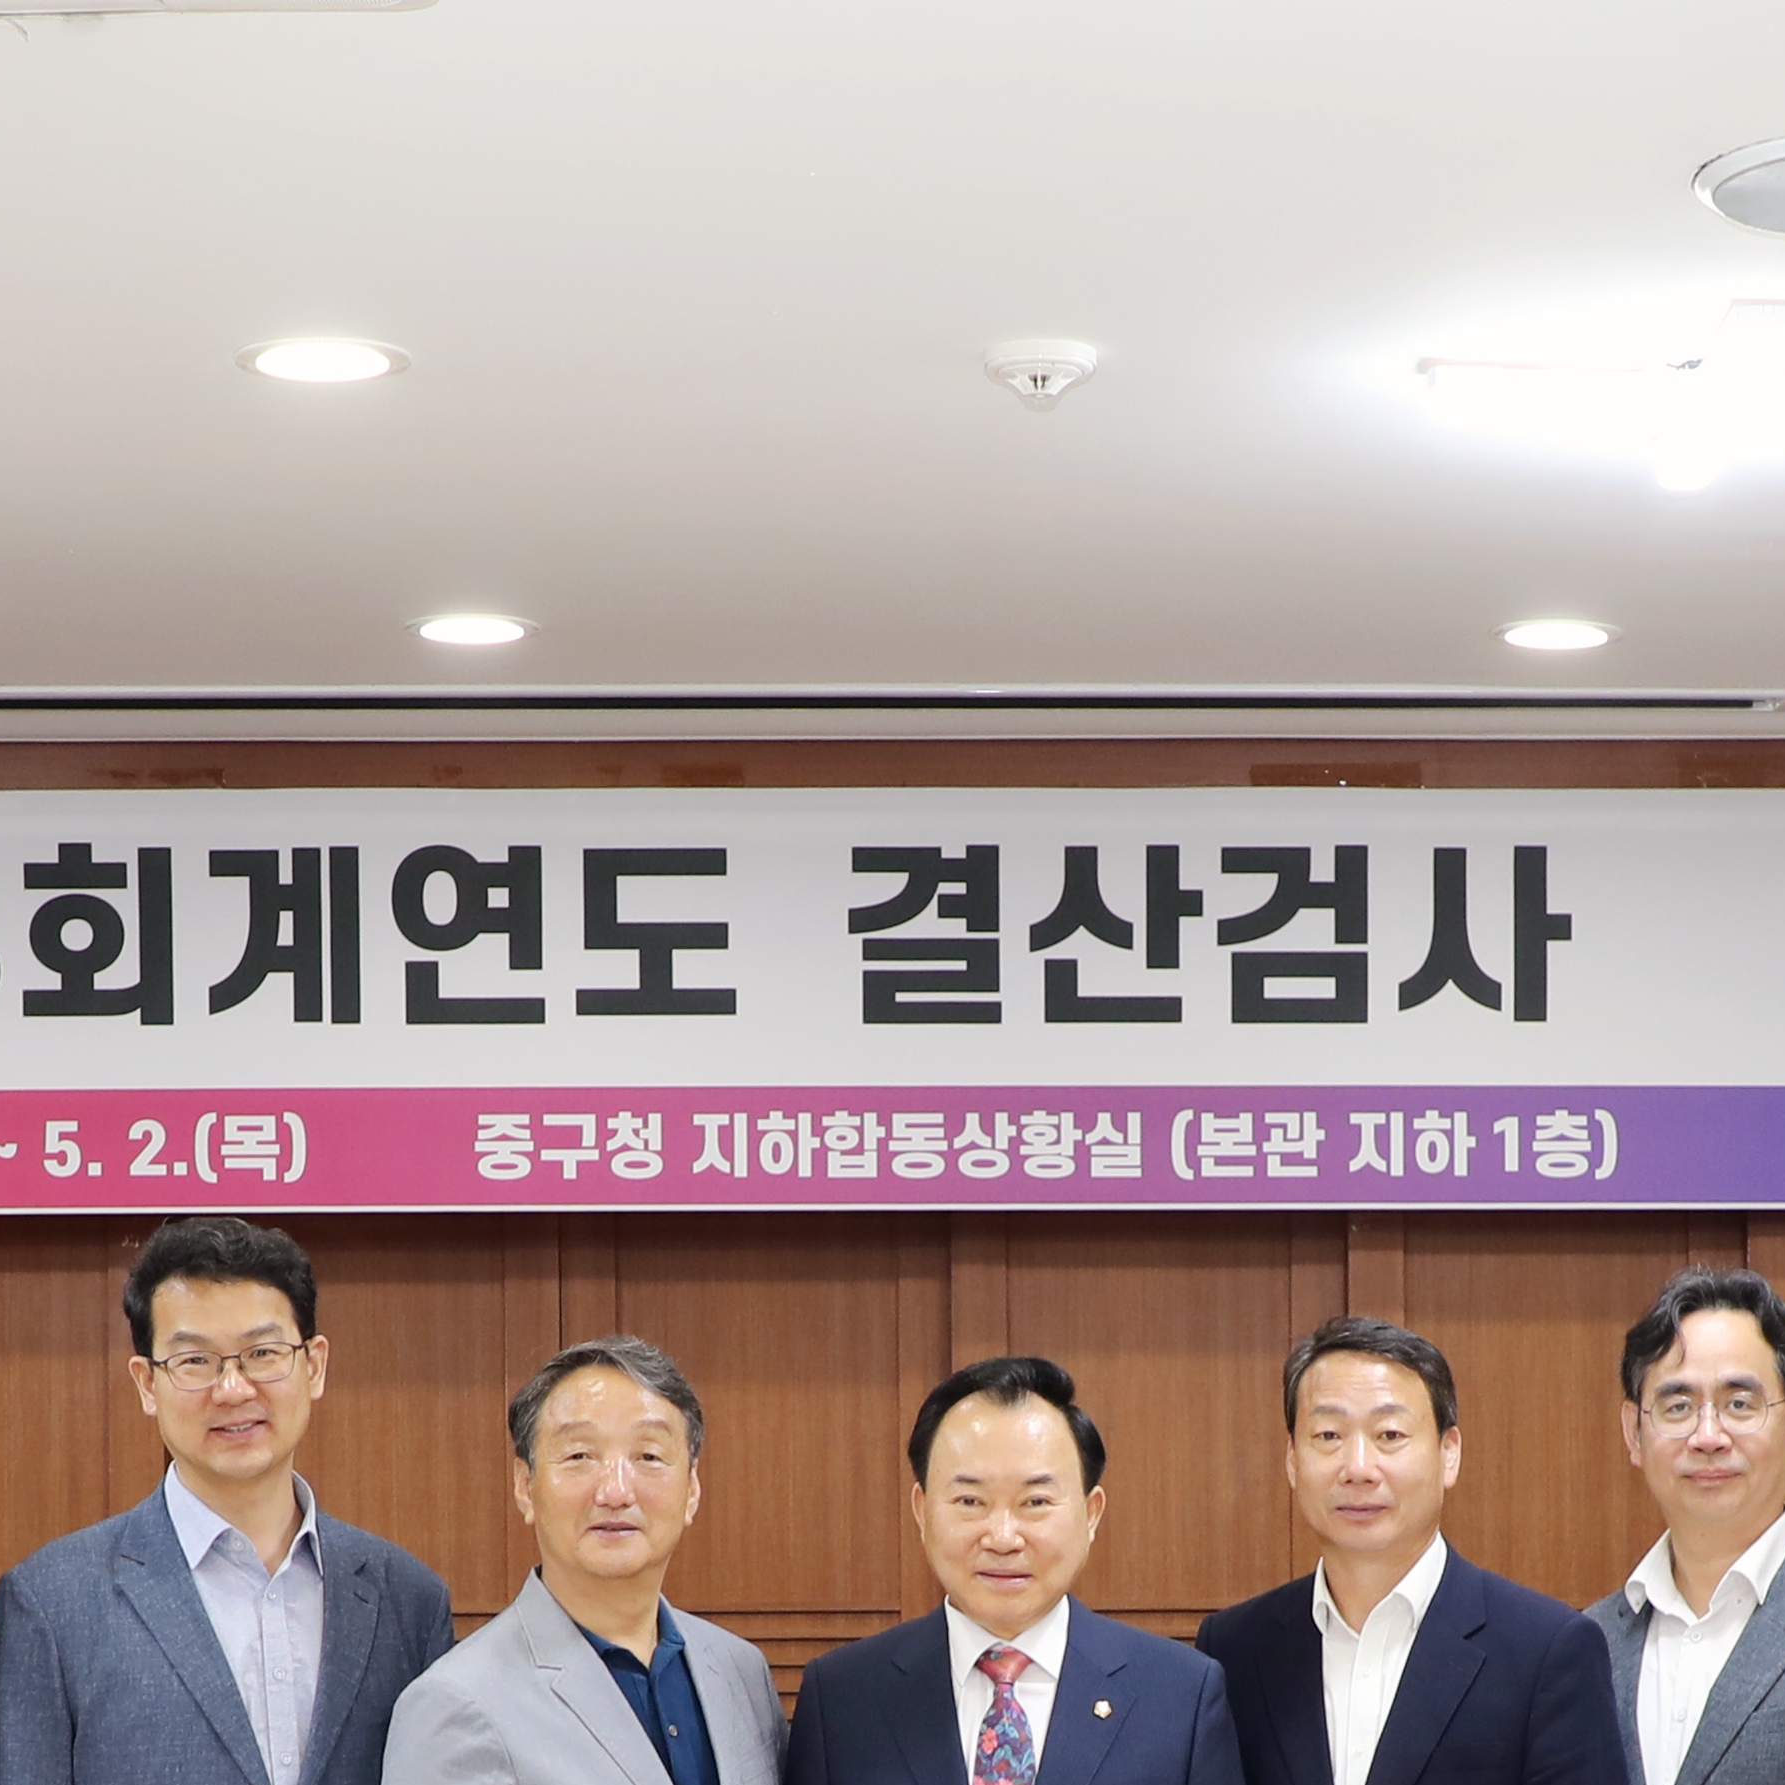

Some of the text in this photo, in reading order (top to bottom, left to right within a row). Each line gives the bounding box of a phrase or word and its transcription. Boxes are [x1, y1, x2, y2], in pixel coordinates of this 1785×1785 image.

[846, 844, 1573, 1026] 결산검사
[42, 1119, 103, 1178] 5.
[127, 1111, 308, 1185] 2.(목)
[473, 1110, 665, 1181] 중구청
[690, 1109, 1143, 1180] 지하합동상황실
[1169, 1108, 1327, 1182] (본관
